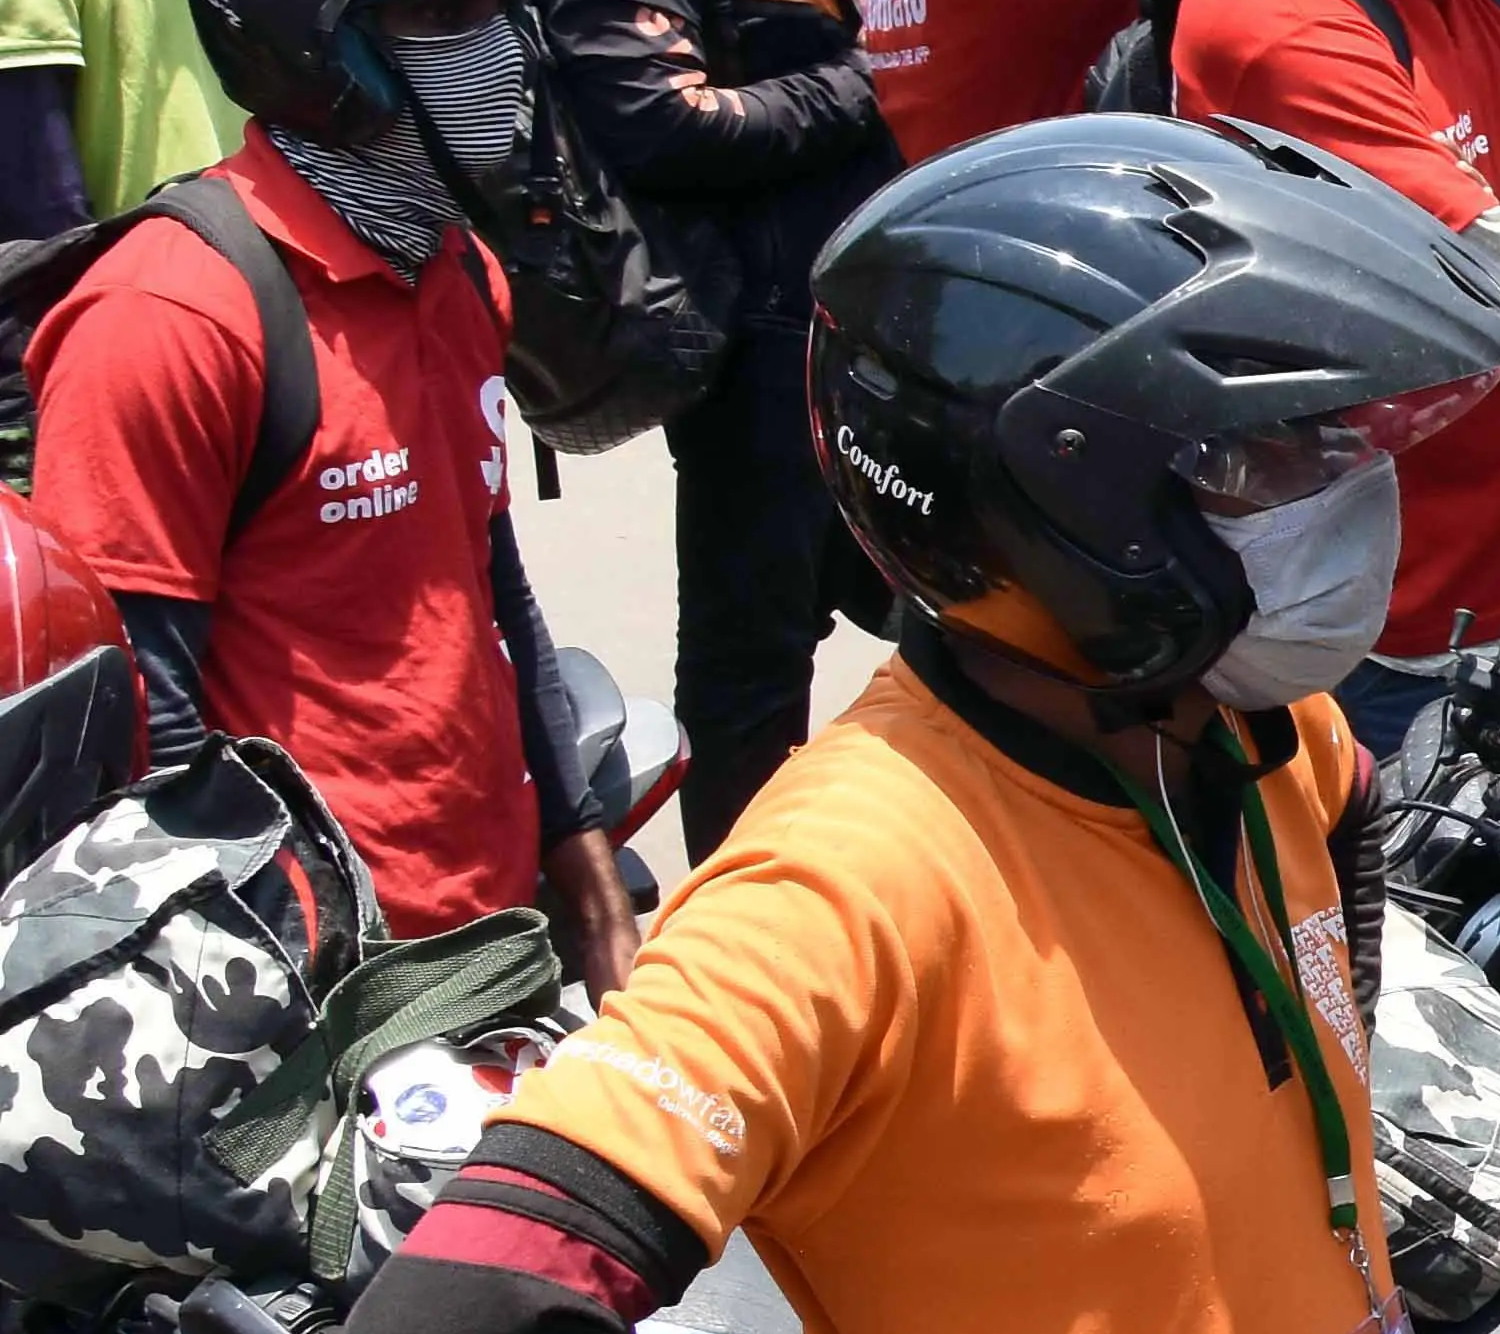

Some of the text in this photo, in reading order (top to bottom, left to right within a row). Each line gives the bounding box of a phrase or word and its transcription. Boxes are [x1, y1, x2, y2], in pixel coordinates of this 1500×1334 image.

[320, 446, 410, 492] order
[836, 424, 935, 516] Comfort
[318, 479, 419, 524] online
